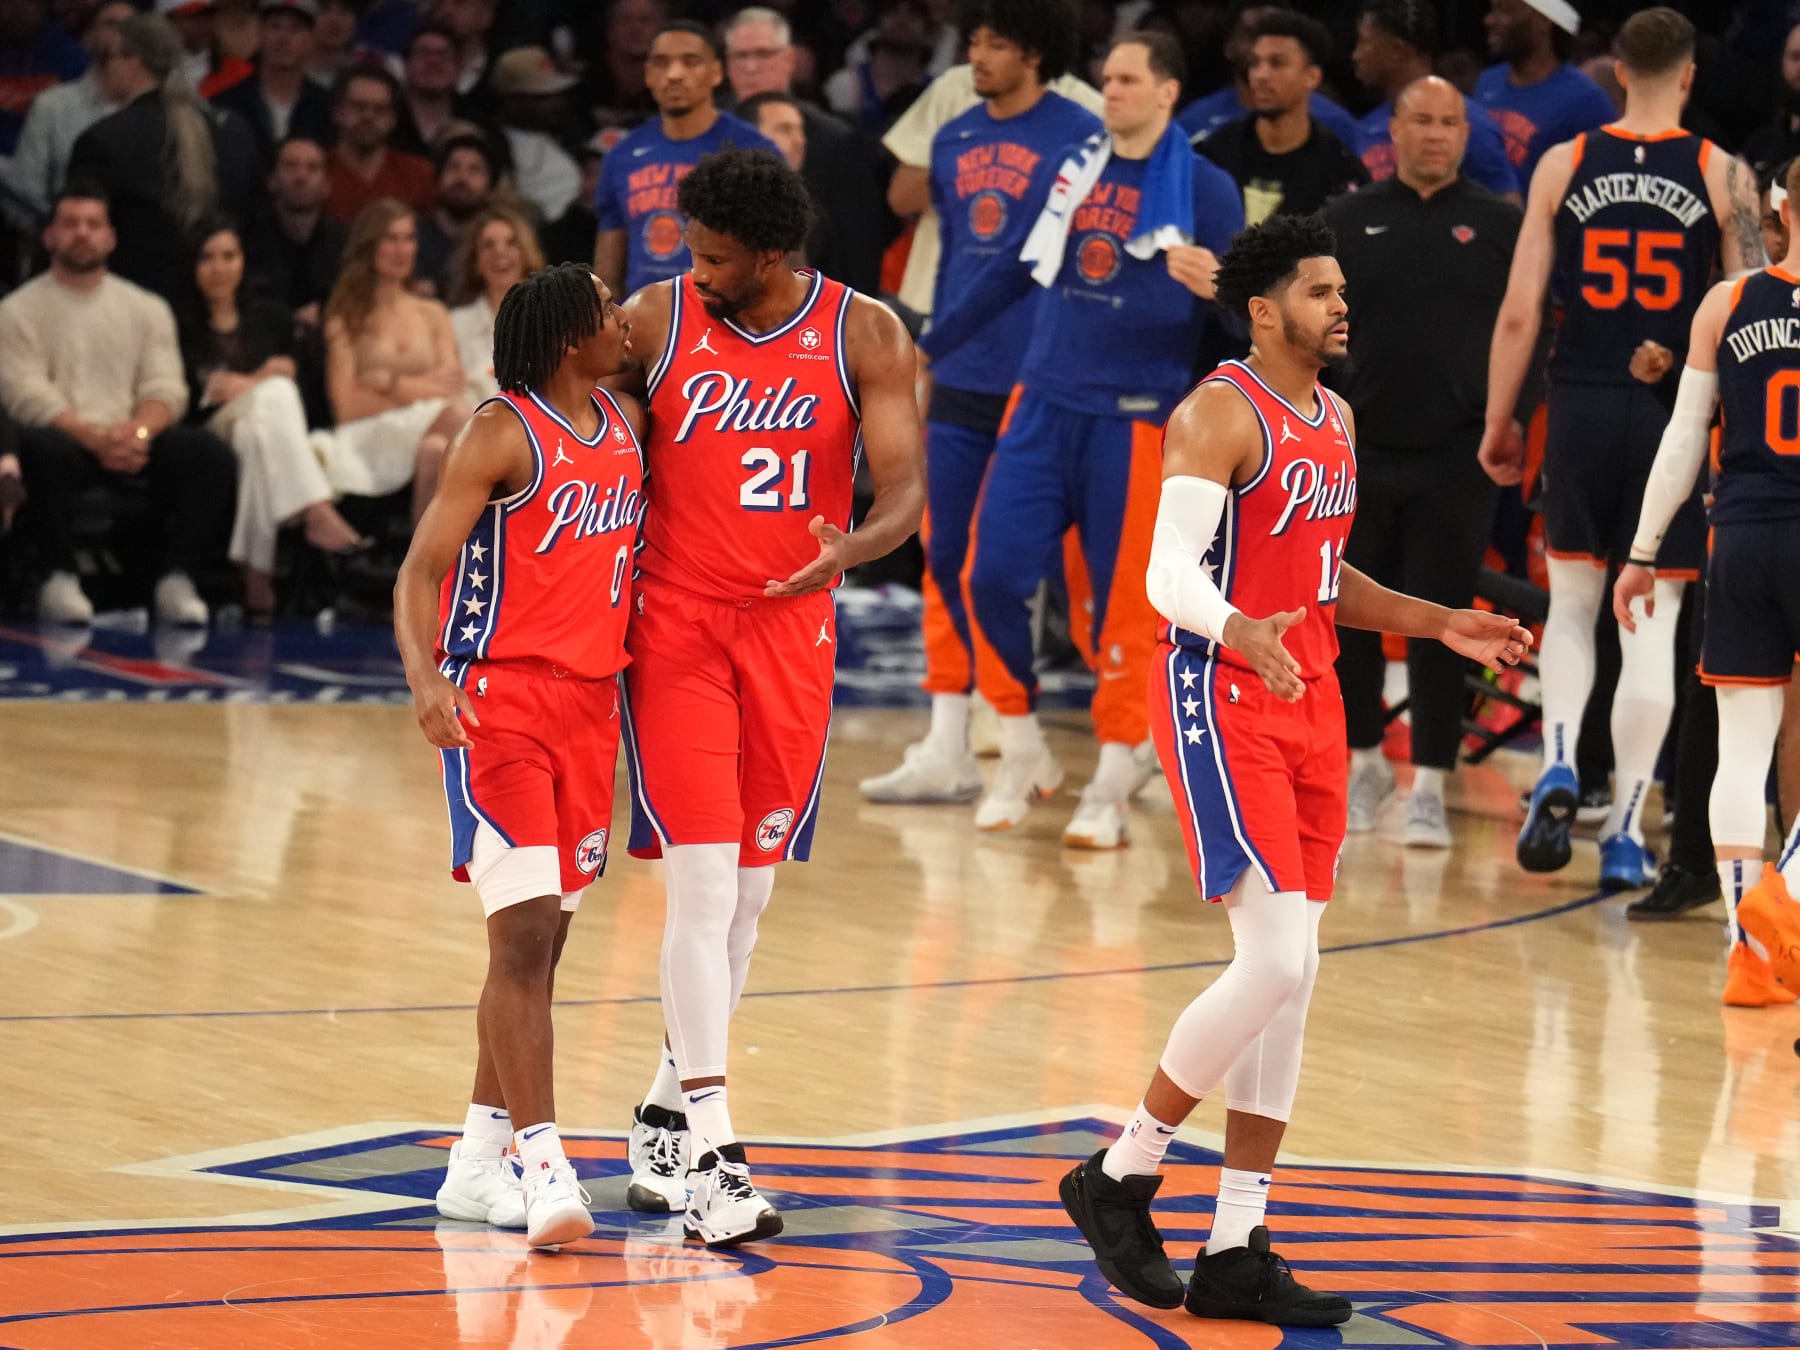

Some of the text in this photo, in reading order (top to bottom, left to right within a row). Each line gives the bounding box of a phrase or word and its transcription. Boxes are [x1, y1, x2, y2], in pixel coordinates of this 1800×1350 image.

[1565, 172, 1709, 228] HARTENSTEIN
[1582, 228, 1685, 311] 55
[788, 352, 830, 361] crypto.com
[1727, 317, 1800, 364] DIVINC
[673, 370, 821, 444] Phila
[1765, 369, 1800, 456] 0
[739, 447, 811, 512] 21
[1269, 457, 1357, 537] Phila
[534, 474, 640, 555] Phila
[610, 545, 628, 608] 0
